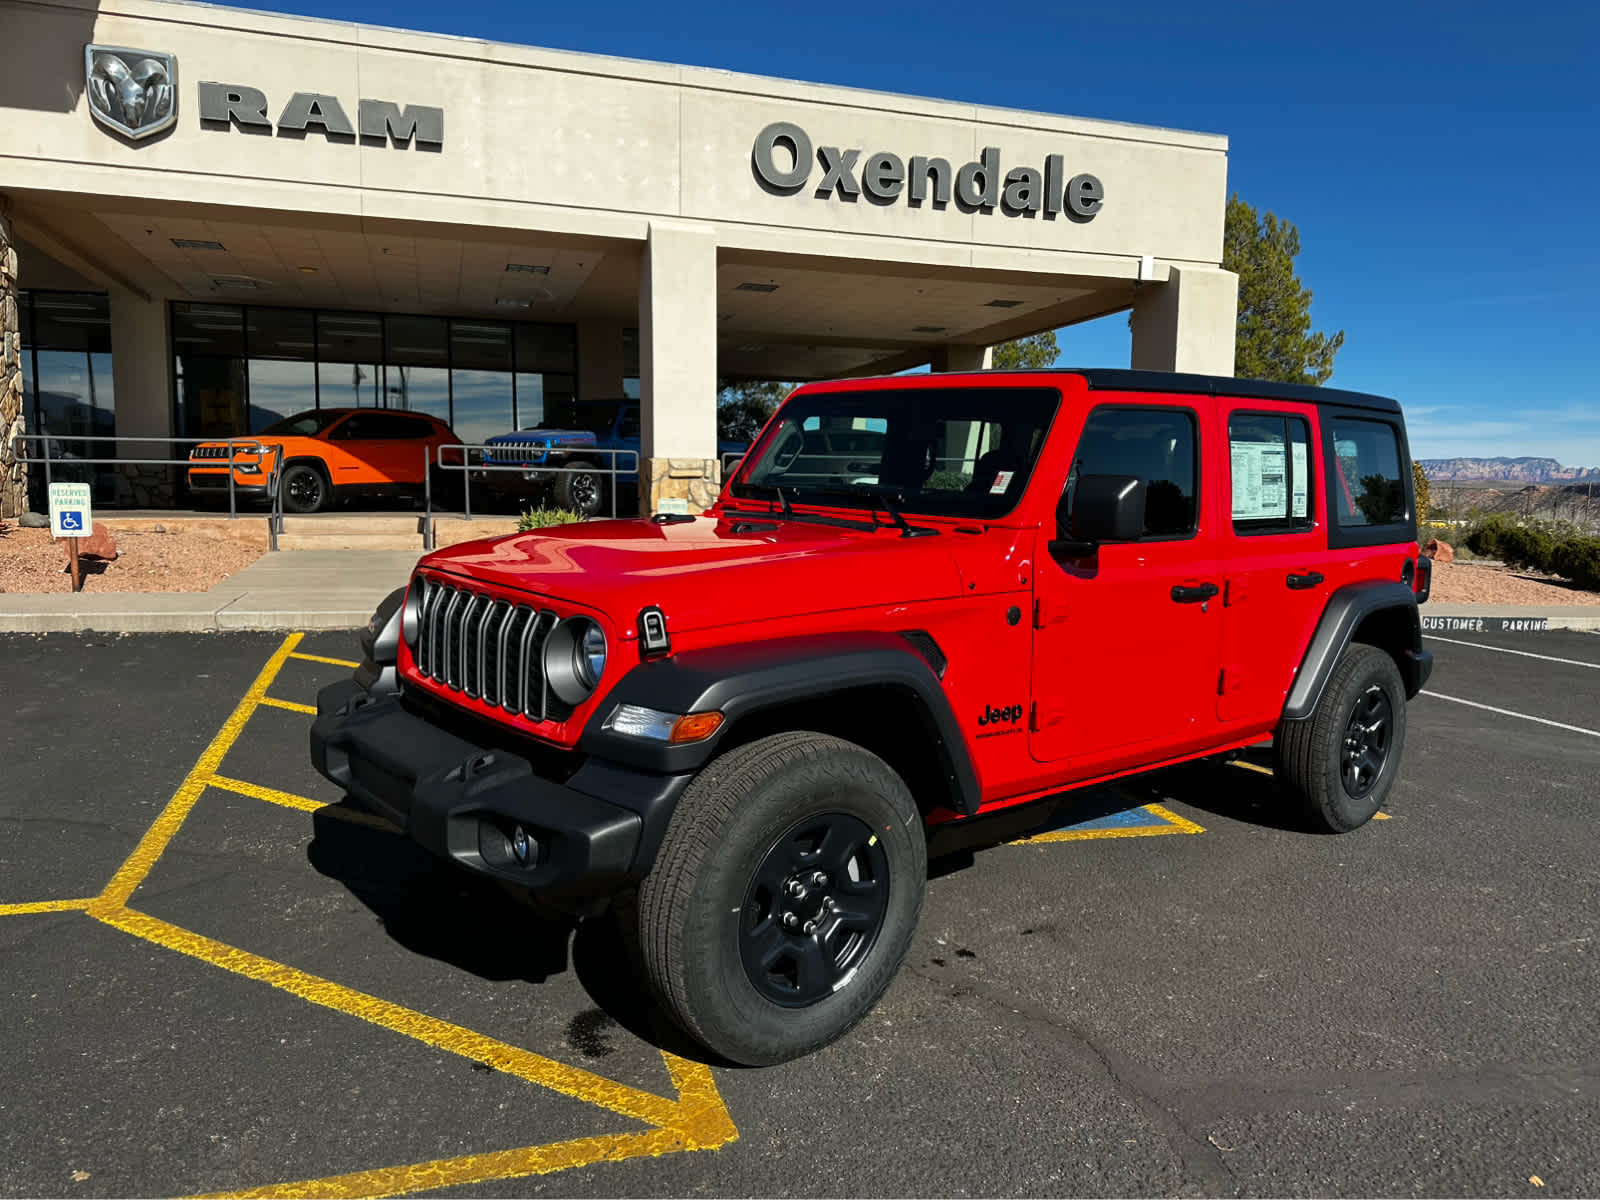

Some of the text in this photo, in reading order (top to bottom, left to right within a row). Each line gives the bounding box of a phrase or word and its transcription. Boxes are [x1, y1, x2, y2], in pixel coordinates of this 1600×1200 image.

[198, 80, 444, 154] RAM
[751, 121, 1105, 224] Oxendale
[55, 498, 86, 506] PARKING
[1422, 617, 1548, 631] CUSTOMER PARKING
[978, 704, 1022, 726] Jeep
